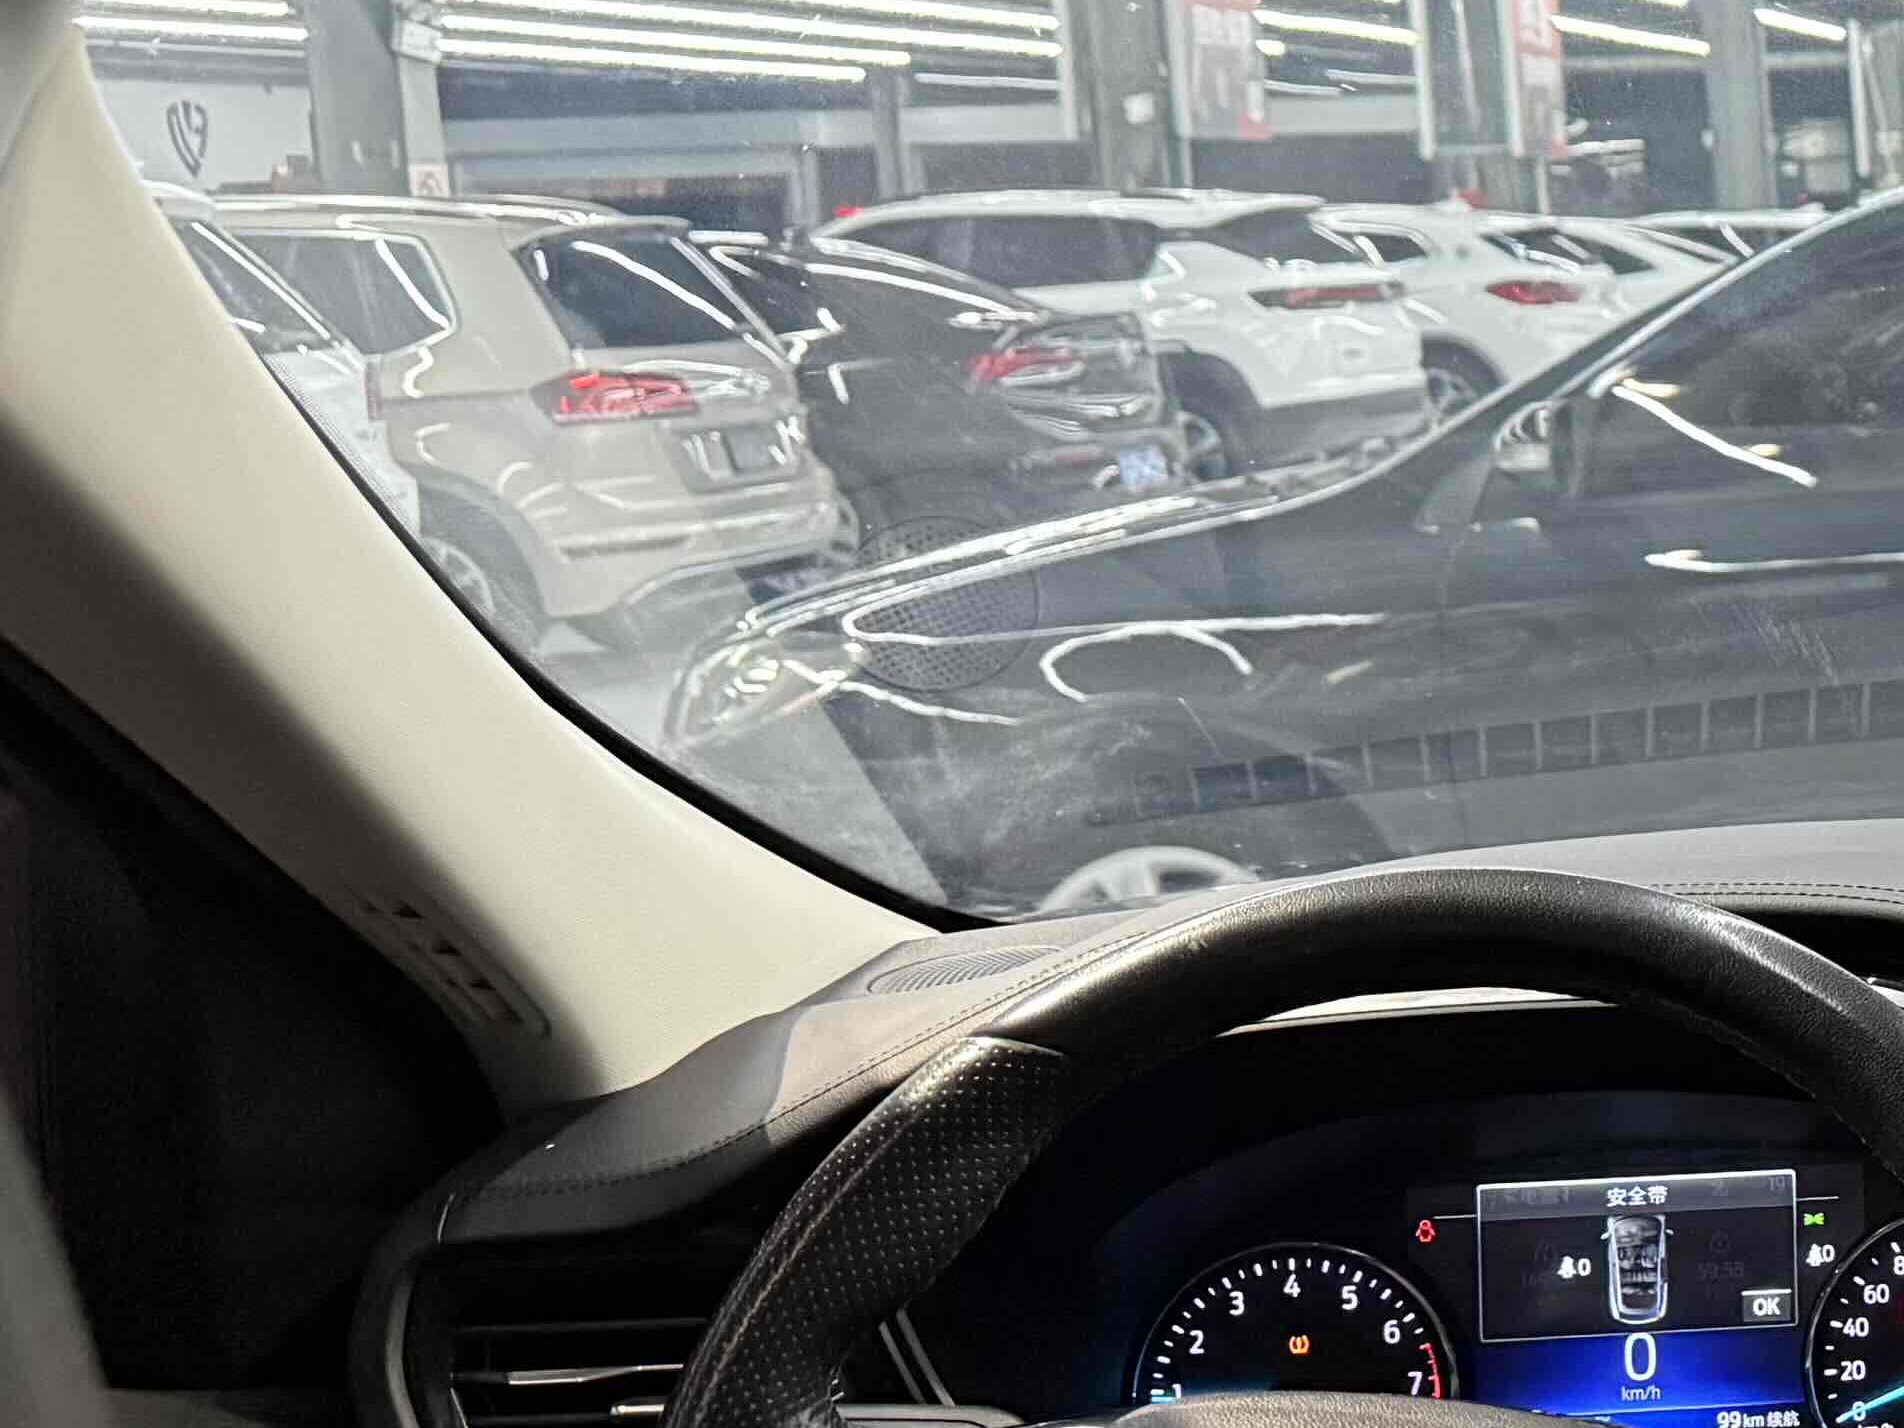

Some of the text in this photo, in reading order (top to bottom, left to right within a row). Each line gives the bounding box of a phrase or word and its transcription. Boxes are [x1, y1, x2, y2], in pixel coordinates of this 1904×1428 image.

[1606, 1185, 1669, 1208] 安全带
[1283, 1273, 1301, 1298] 4
[1341, 1284, 1359, 1311] 5
[1863, 1283, 1890, 1304] 60
[1228, 1290, 1245, 1316] 3
[1752, 1297, 1781, 1317] OK
[1382, 1319, 1401, 1344] 6
[1842, 1316, 1870, 1338] 40
[1188, 1329, 1205, 1355] 2
[1623, 1332, 1657, 1382] 0
[1840, 1359, 1867, 1382] 20
[1407, 1370, 1423, 1396] 7
[1620, 1385, 1662, 1402] km/h
[1742, 1412, 1765, 1428] km
